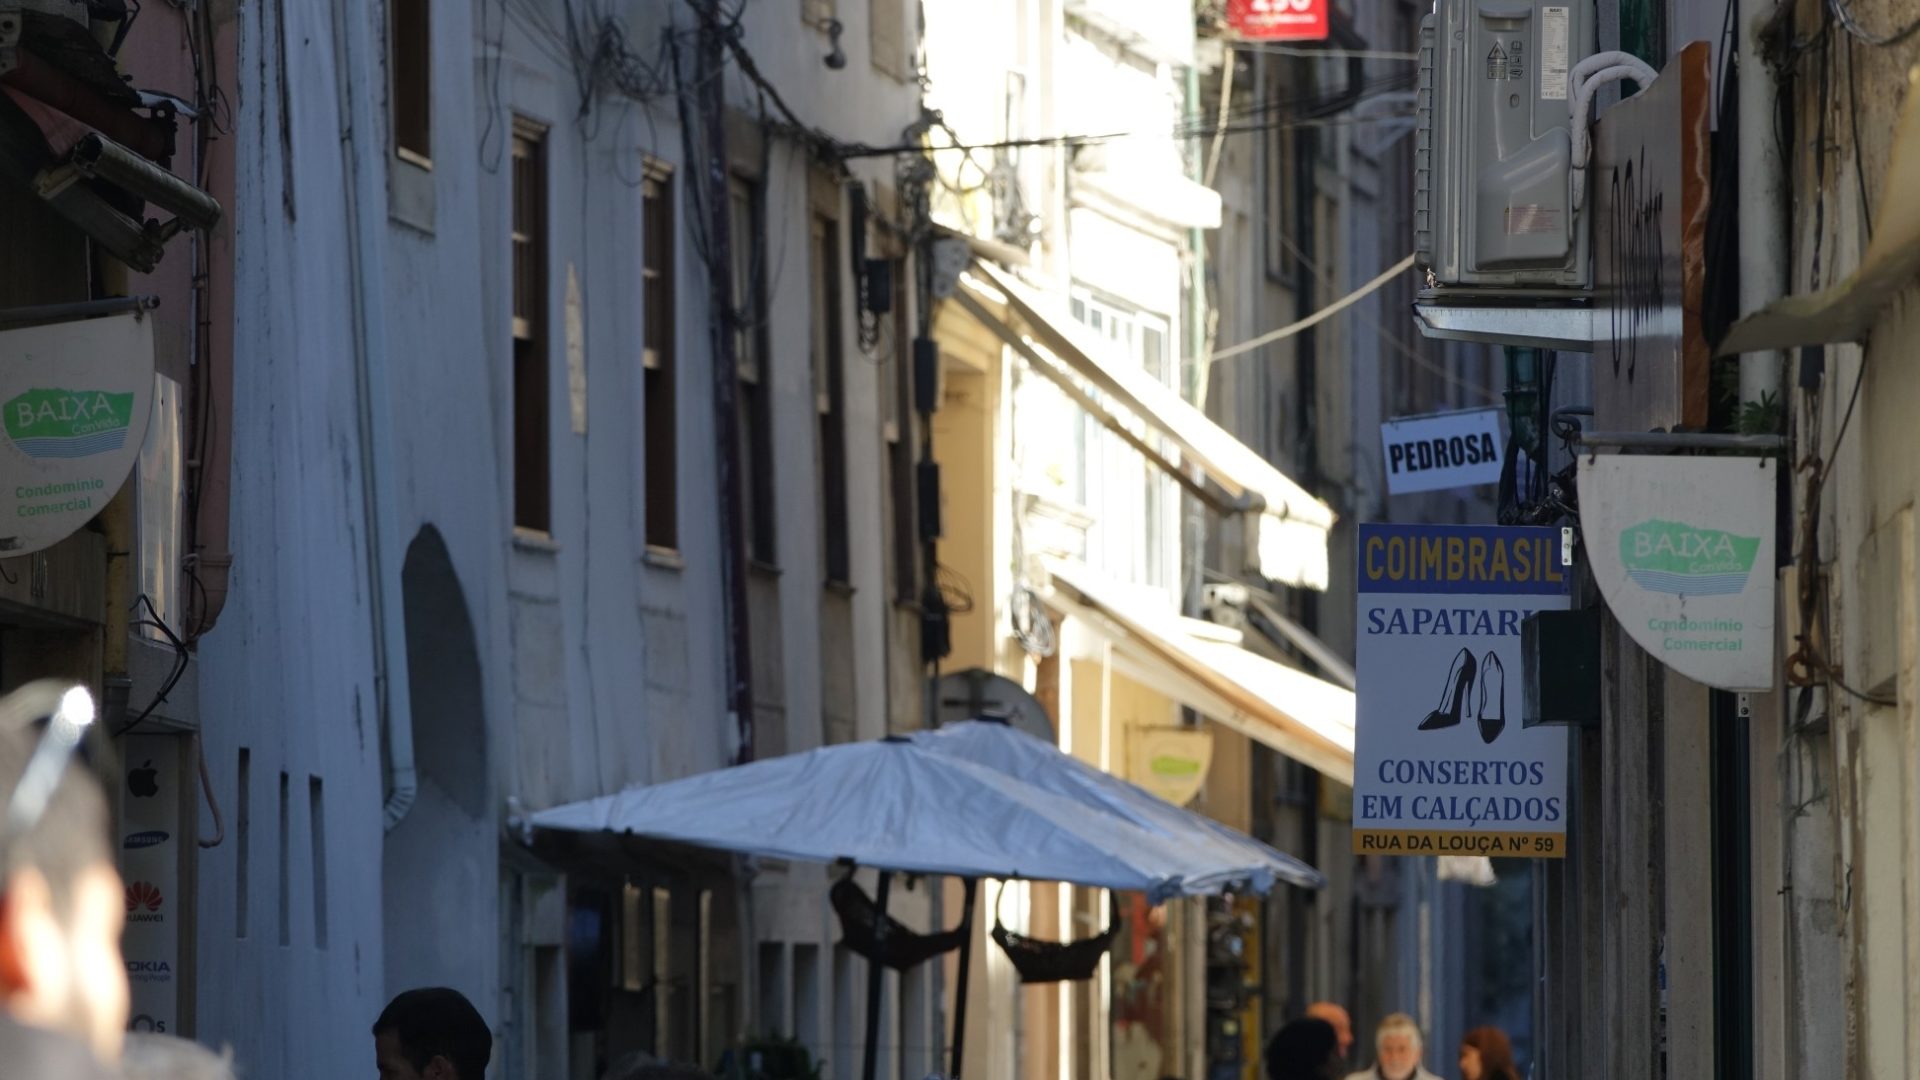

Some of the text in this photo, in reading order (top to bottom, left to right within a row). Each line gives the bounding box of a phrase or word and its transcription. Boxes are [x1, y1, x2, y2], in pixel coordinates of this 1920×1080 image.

[16, 393, 114, 428] BAIXA
[1388, 432, 1497, 474] PEDROSA
[16, 496, 92, 517] Comercial
[1634, 531, 1736, 559] BAIXA
[1366, 536, 1564, 582] COIMBRASIL
[1663, 637, 1743, 651] Comercial
[1378, 759, 1544, 786] CONSERTOS
[1361, 794, 1561, 827] EM CALÇADOS
[1362, 834, 1554, 854] RUA DA LOUÇA Nº 59
[127, 961, 171, 972] OKIA
